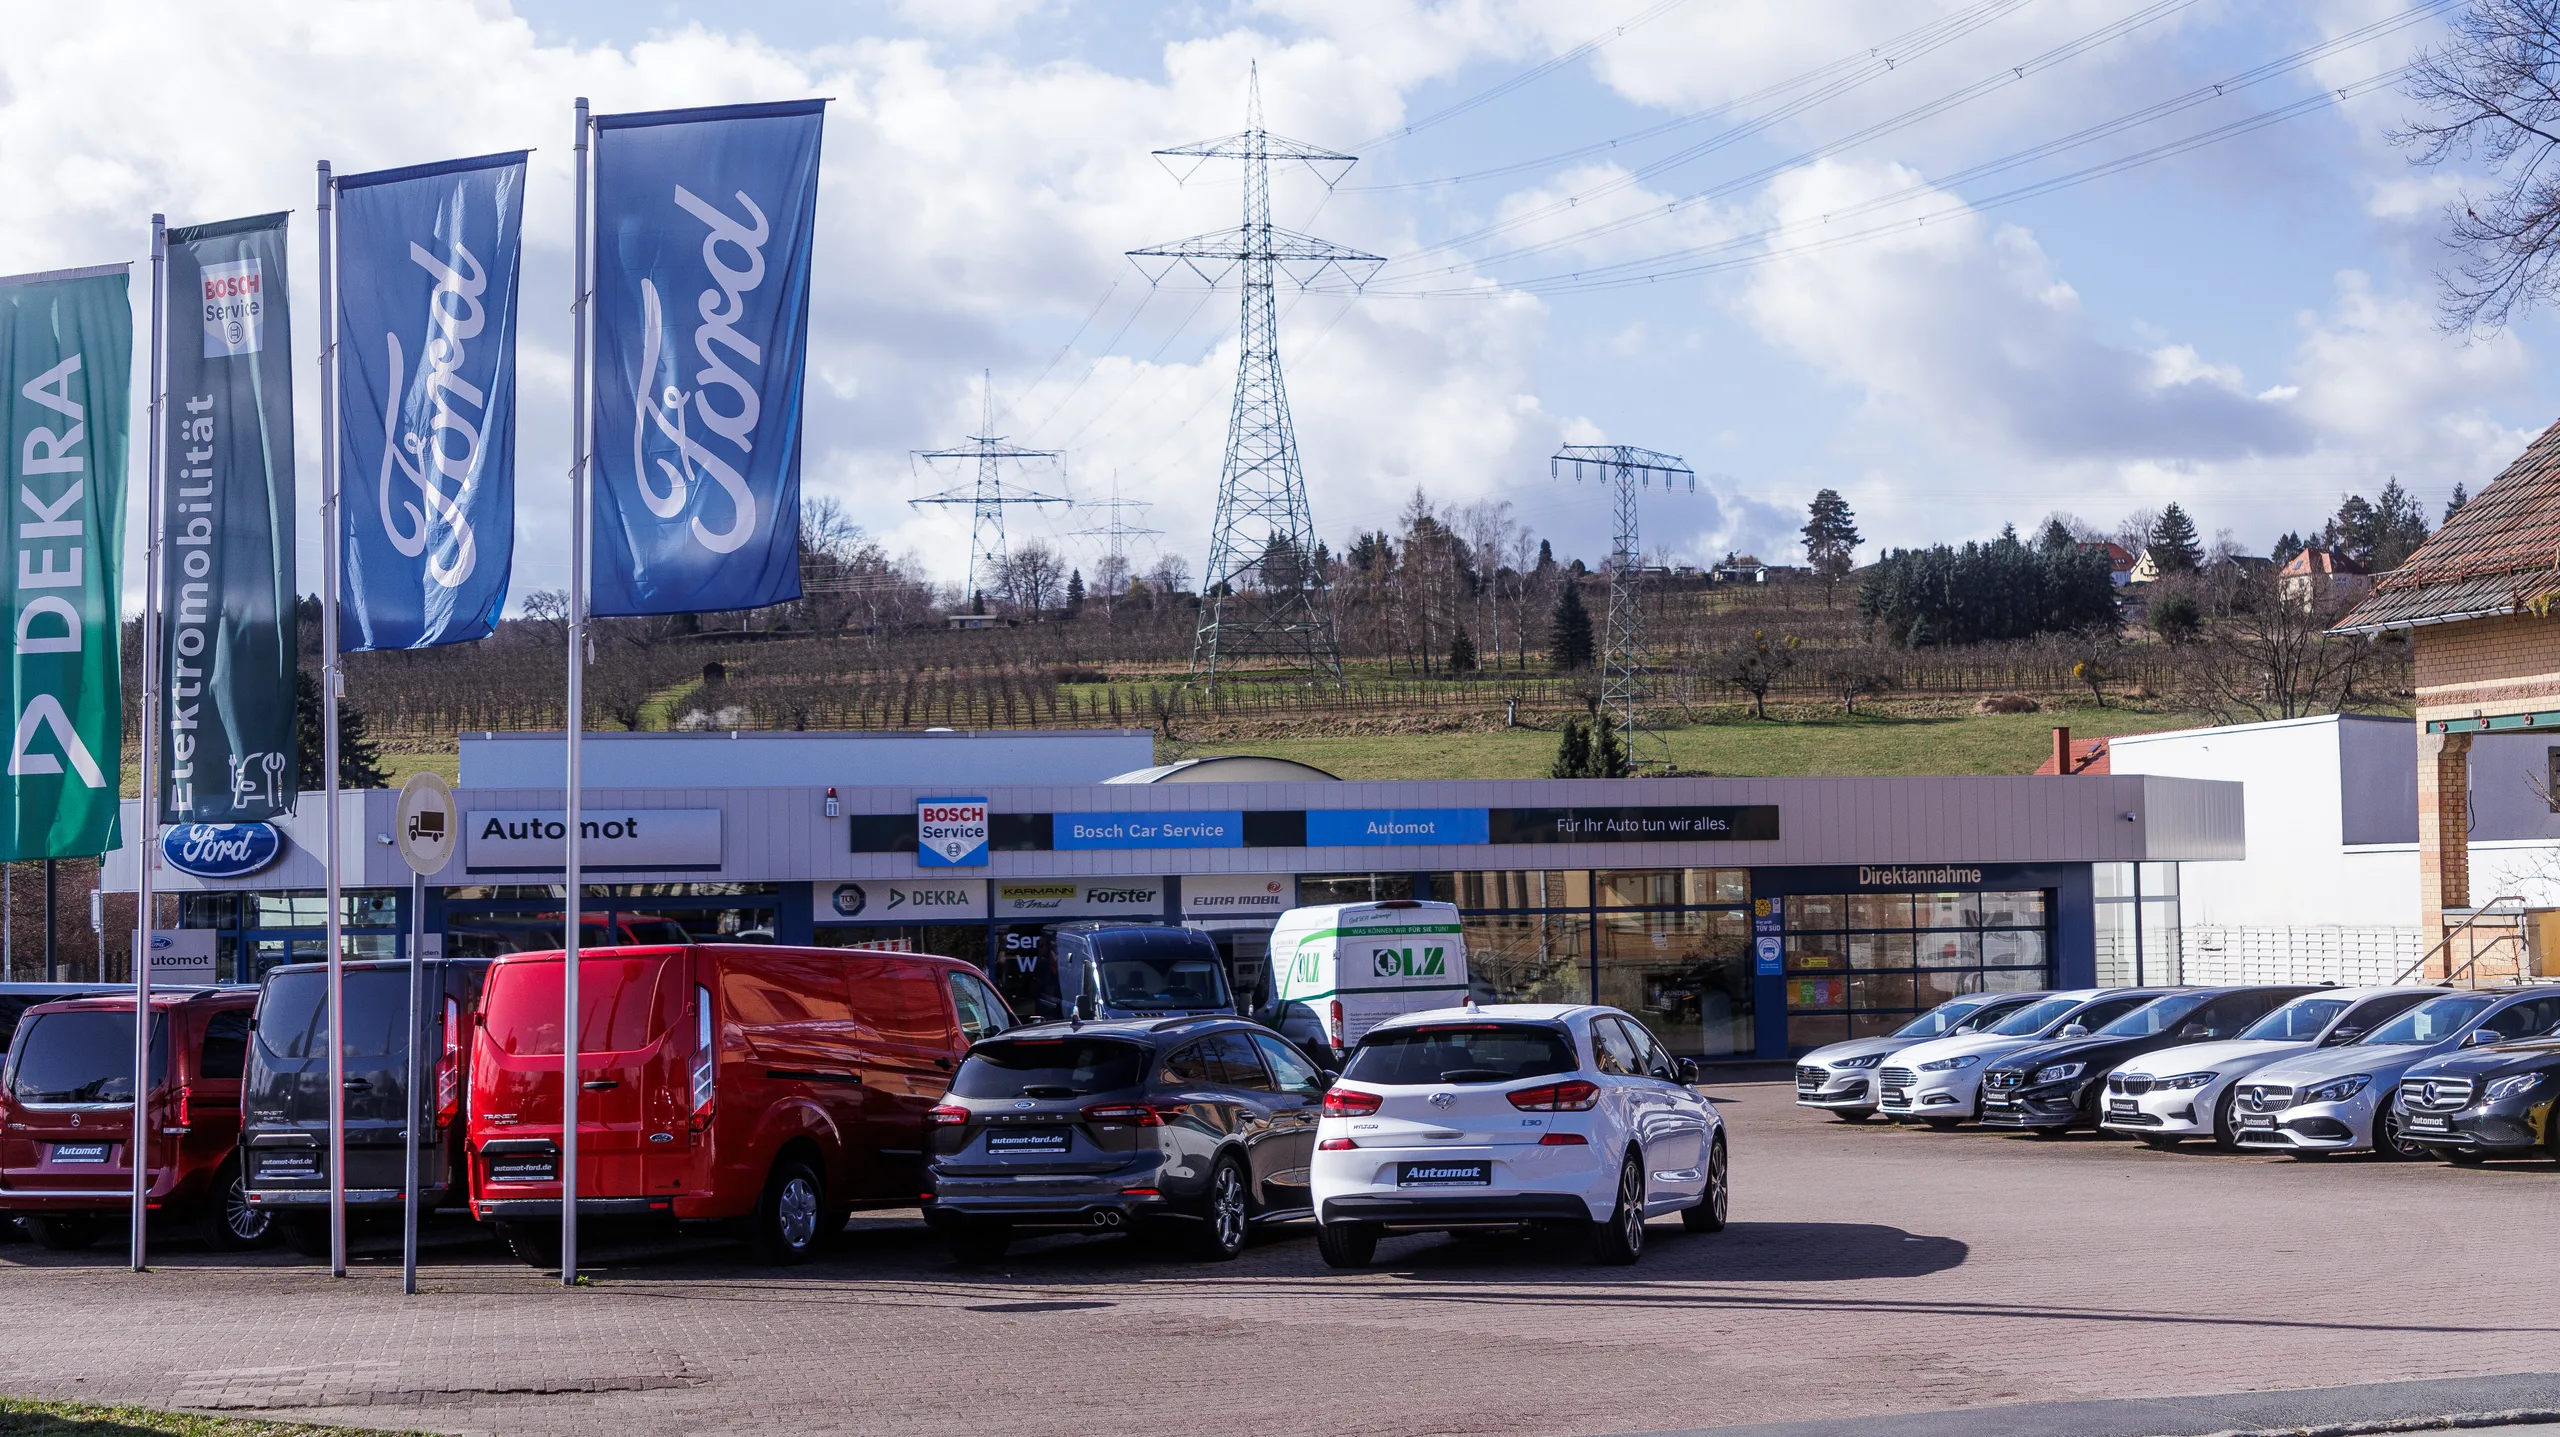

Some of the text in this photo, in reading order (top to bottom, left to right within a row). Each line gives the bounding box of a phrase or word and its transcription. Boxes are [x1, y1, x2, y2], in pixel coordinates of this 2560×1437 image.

[204, 274, 260, 300] BOSCH
[205, 298, 260, 322] Service
[634, 183, 769, 554] Ford
[379, 241, 486, 588] Ford
[16, 353, 84, 655] DEKRA
[170, 393, 215, 812] Elektromobilität
[923, 807, 984, 823] BOSCH
[481, 817, 638, 840] Automot
[922, 825, 985, 840] Service
[1073, 822, 1225, 838] Bosch Car Service
[1367, 820, 1435, 836] Automot
[1557, 817, 1730, 833] Für Ihr Auto tun wir alles.
[182, 823, 252, 862] Ford
[1858, 865, 1982, 886] Direktannahme
[912, 890, 969, 906] DEKRA
[1004, 887, 1074, 896] KARMANN
[1086, 888, 1156, 904] Forster
[1193, 895, 1281, 906] EURA MOBIL
[1367, 926, 1394, 934] KÖNNEN
[1408, 925, 1421, 933] FÜR
[1756, 924, 1781, 932] TÜV SÜD
[151, 955, 209, 966] utomot
[2111, 1101, 2134, 1110] Automot
[985, 1114, 1064, 1122] FOCUS
[2243, 1118, 2270, 1127] Automot
[2411, 1115, 2443, 1126] Automot
[991, 1136, 1063, 1144] automot-ford.de
[57, 1146, 103, 1155] Automot
[493, 1164, 553, 1172] automot-ford.de
[1406, 1166, 1481, 1179] Automot
